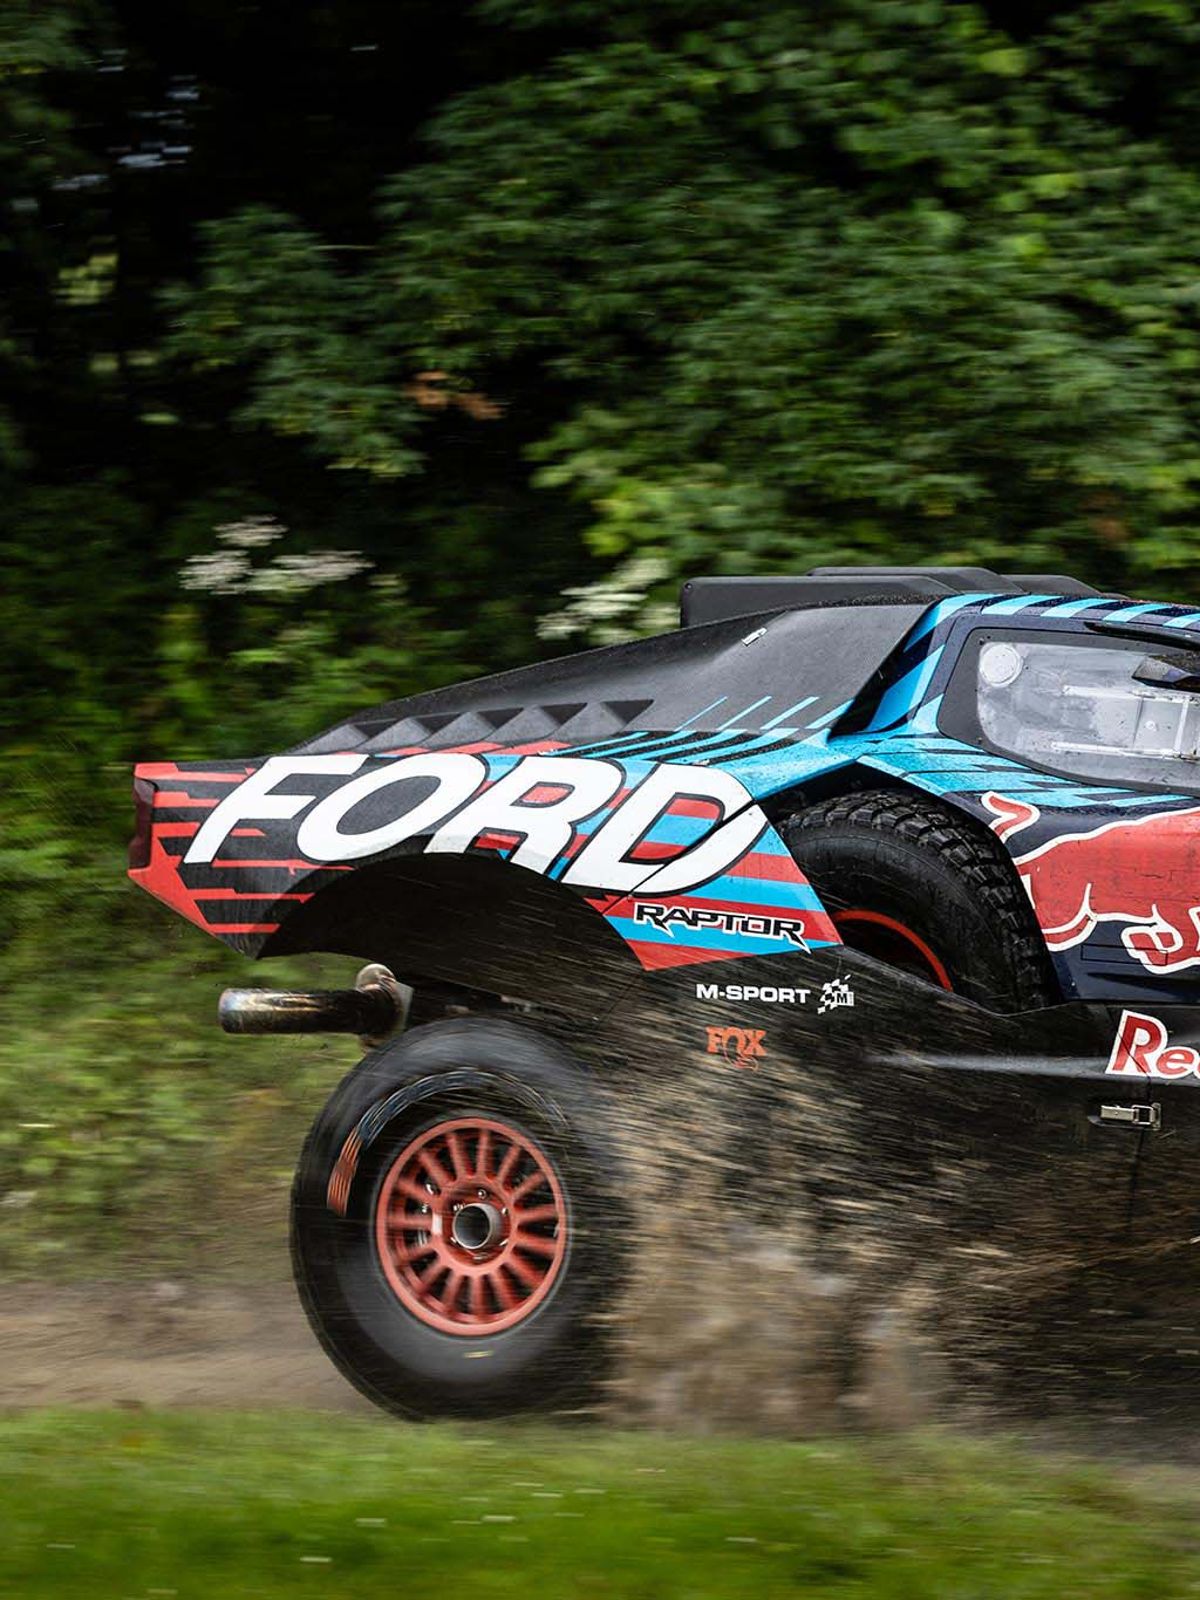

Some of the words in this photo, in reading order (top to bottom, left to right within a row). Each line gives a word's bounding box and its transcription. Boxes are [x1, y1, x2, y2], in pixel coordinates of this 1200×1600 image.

[183, 754, 767, 893] FORD
[633, 902, 811, 954] RAPTOR
[696, 984, 811, 1004] M-SPORT
[705, 1025, 767, 1070] FOX
